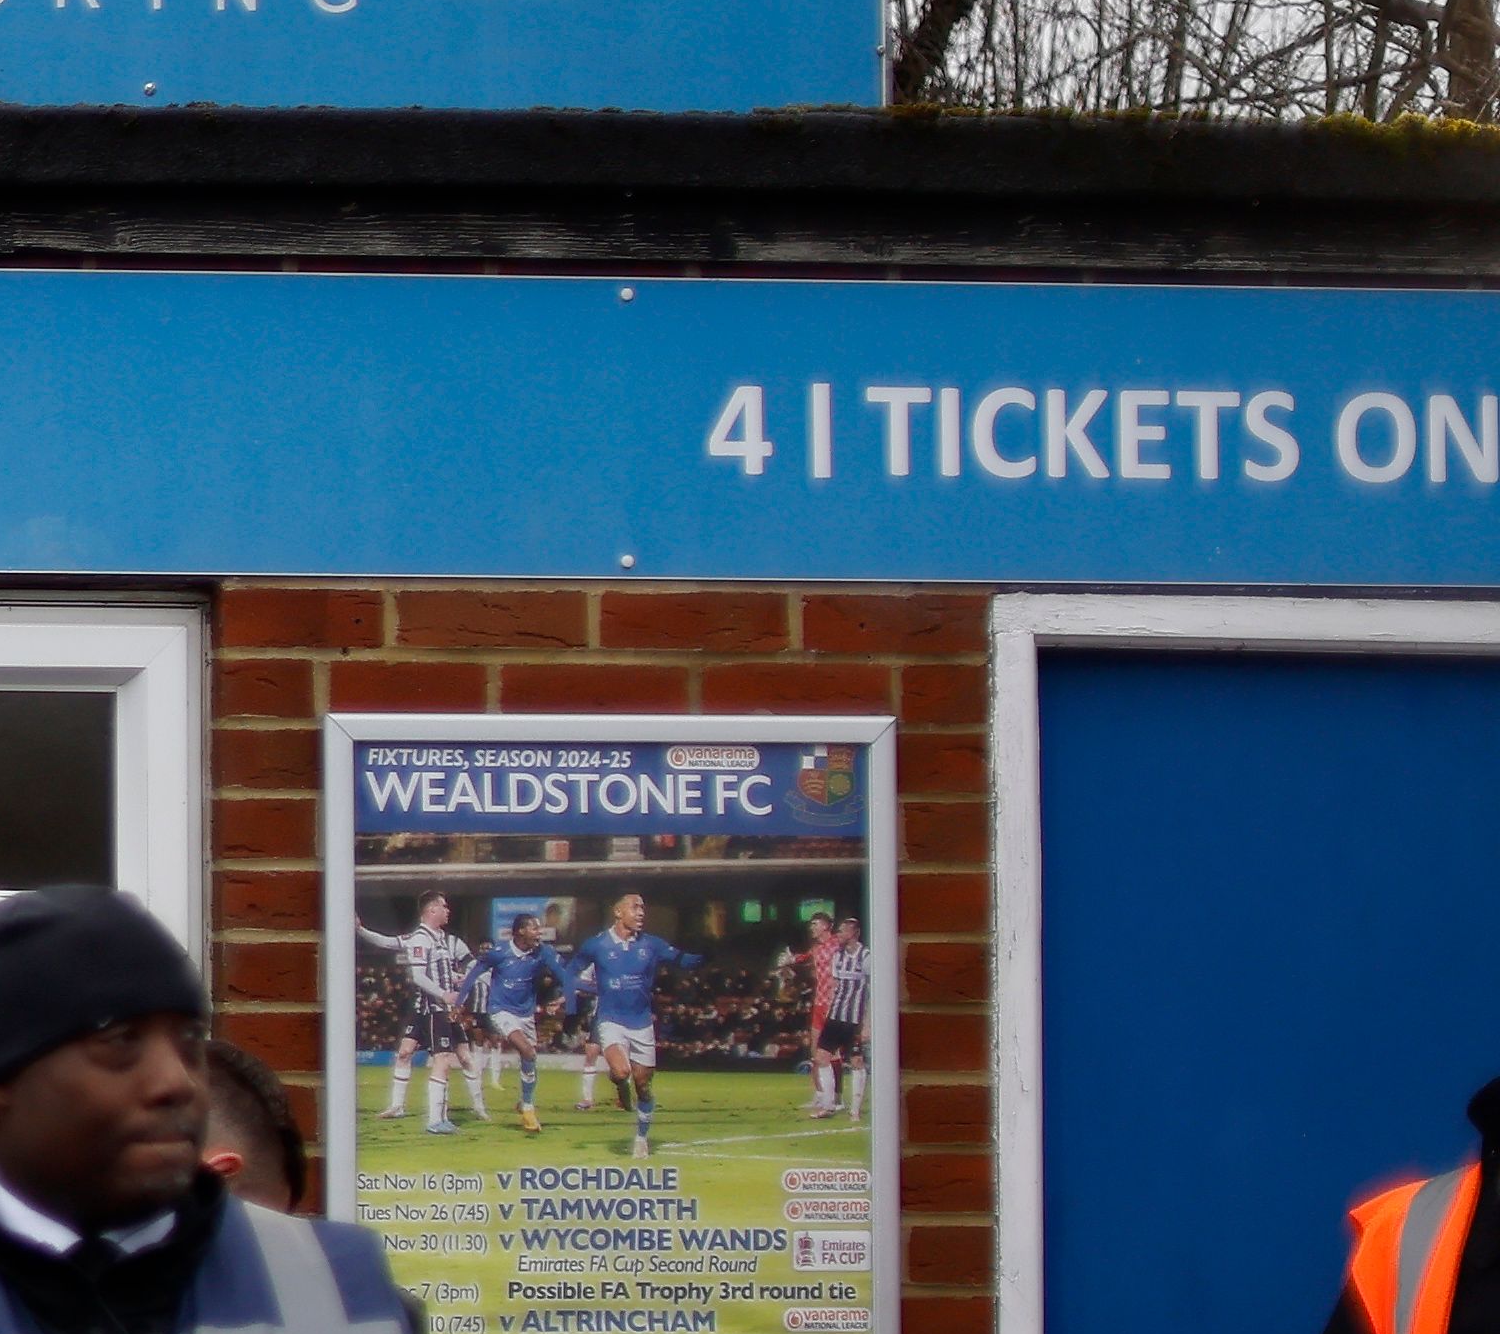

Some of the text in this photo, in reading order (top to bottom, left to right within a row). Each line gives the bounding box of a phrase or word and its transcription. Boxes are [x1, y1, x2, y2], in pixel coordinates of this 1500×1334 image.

[708, 385, 1500, 484] 4 TICKETS ON
[367, 748, 632, 770] FIXTURES, SEASON 2024-25
[365, 770, 773, 816] WEALDSTONE FC
[357, 1168, 678, 1195] Sat Nov 16 (3pm) v ROCHDALE
[358, 1204, 391, 1220] Tues
[395, 1204, 427, 1220] Nov
[431, 1205, 448, 1220] 26
[498, 1203, 514, 1220] v
[520, 1198, 697, 1221] TAMWORTH
[384, 1235, 417, 1251] Nov
[421, 1235, 438, 1251] 30
[499, 1234, 514, 1251] v
[521, 1228, 672, 1252] WYCOMBE
[679, 1229, 788, 1252] WANDS
[822, 1240, 866, 1251] Emirates
[518, 1255, 758, 1276] Emirates FA Cup Second Round
[822, 1253, 865, 1265] FA CUP
[435, 1283, 479, 1303] (3pm)
[508, 1282, 595, 1300] Possible
[601, 1282, 630, 1299] FA
[636, 1282, 714, 1304] Trophy
[719, 1282, 754, 1300] 3rd
[759, 1282, 823, 1300] round
[829, 1282, 857, 1300] tie
[500, 1316, 515, 1332] v
[521, 1310, 716, 1333] ALTRINCHAM
